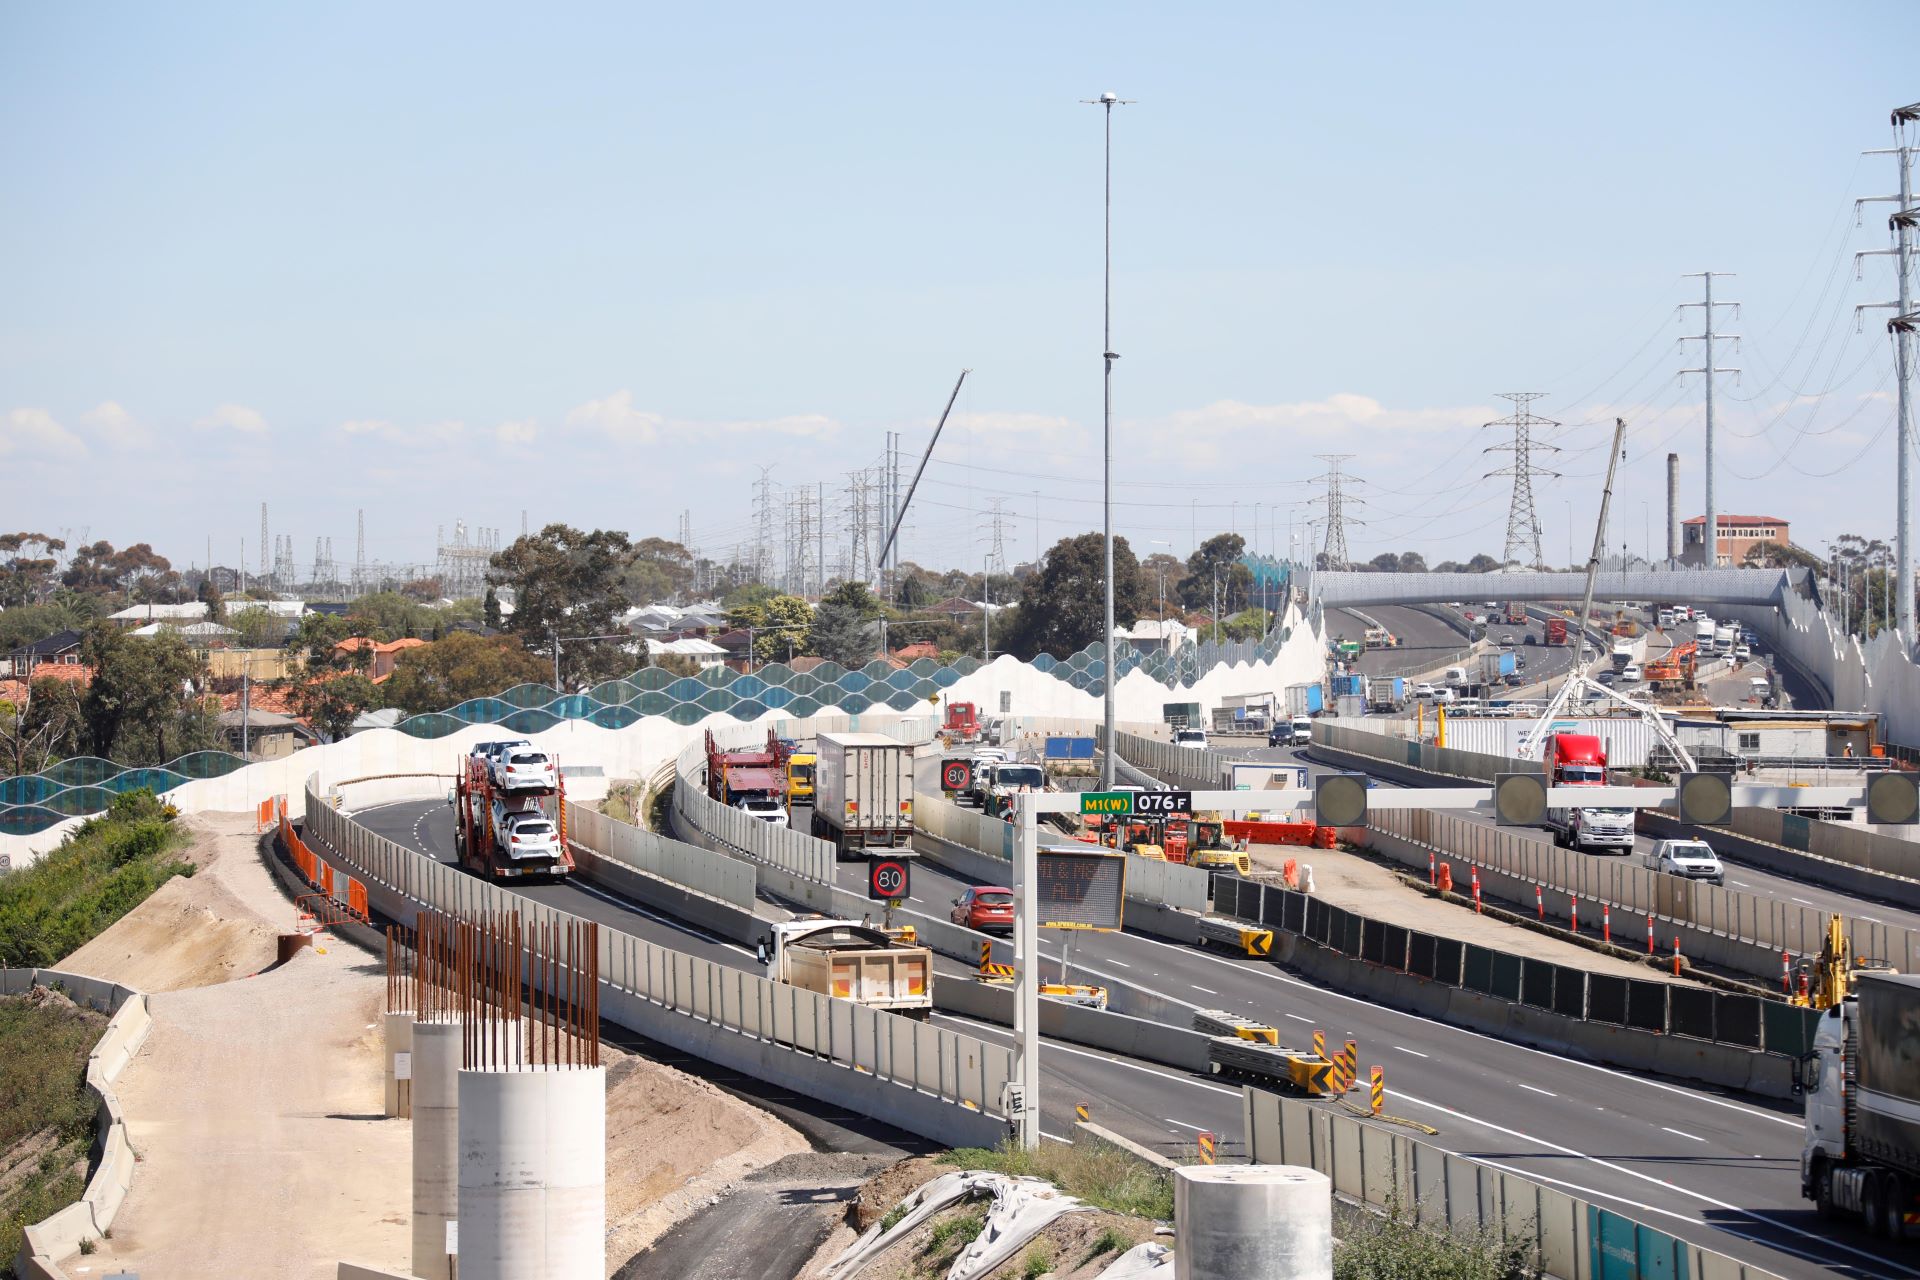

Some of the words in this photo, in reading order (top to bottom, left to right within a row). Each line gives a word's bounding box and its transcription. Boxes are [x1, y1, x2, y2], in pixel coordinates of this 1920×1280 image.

[948, 769, 965, 782] 80
[1085, 798, 1128, 812] M1(W)
[1138, 795, 1175, 810] 076
[1177, 798, 1187, 809] F
[878, 871, 901, 887] 80
